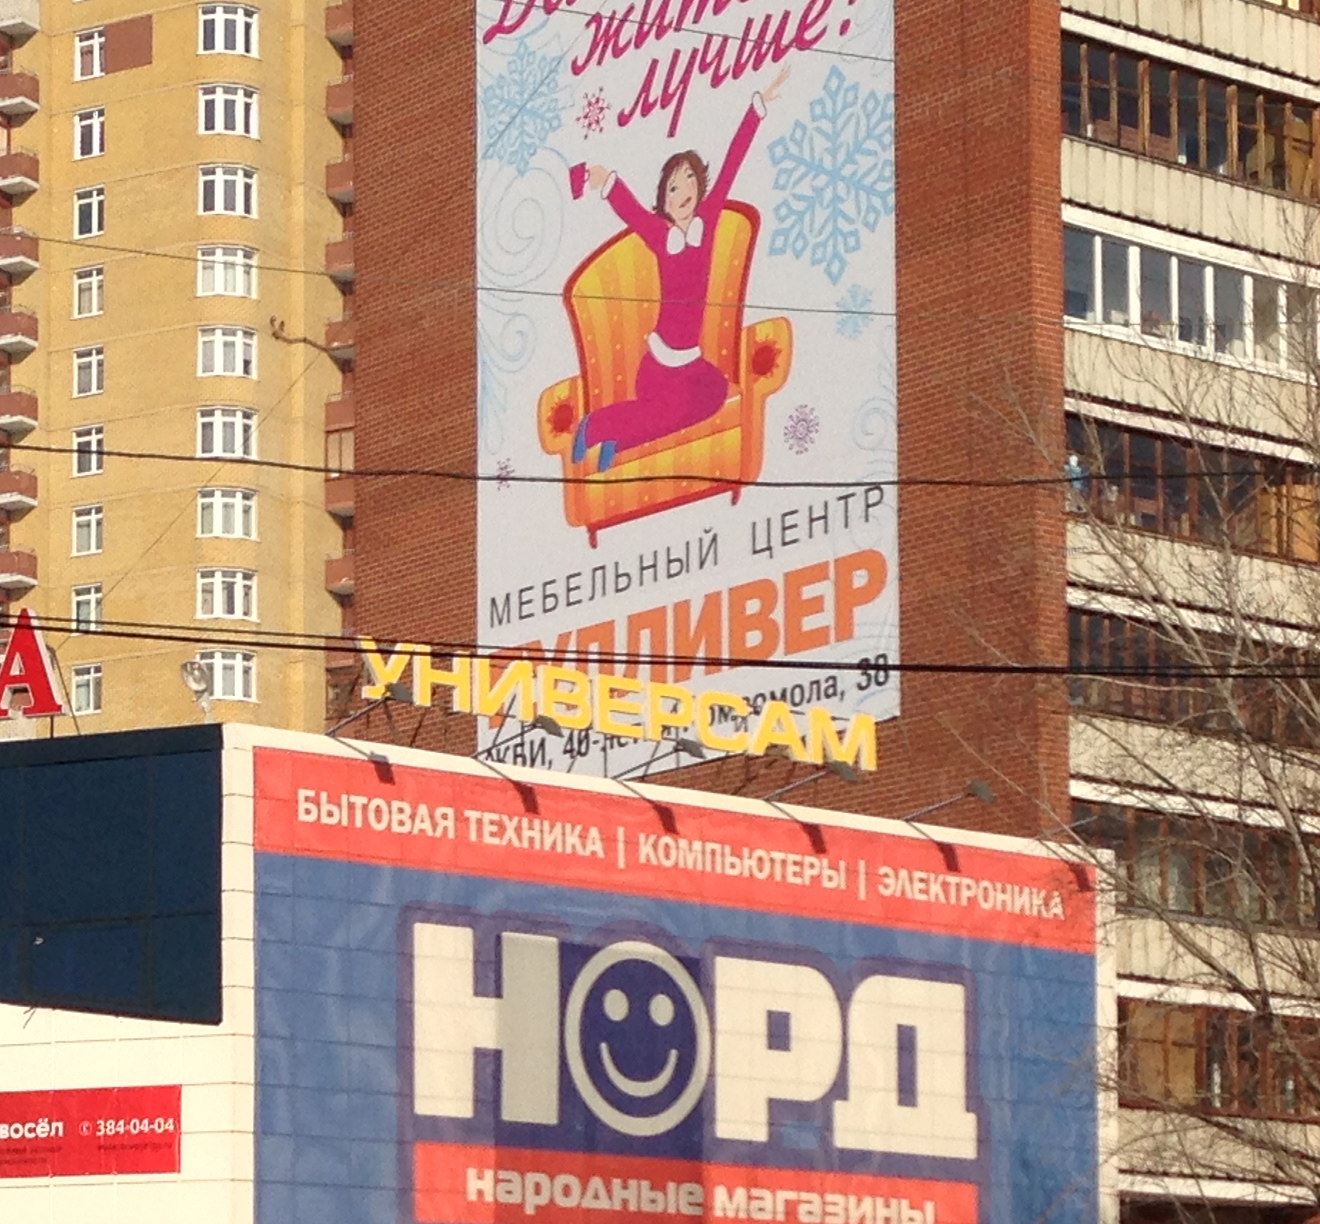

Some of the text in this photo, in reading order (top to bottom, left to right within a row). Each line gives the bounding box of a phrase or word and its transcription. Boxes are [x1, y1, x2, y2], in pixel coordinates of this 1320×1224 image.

[617, 0, 856, 138] лучше
[489, 485, 884, 628] МЕБЕЛЬНЫЙ ЦЕНТР
[356, 635, 878, 771] УНИВЕРСАМ
[296, 788, 1066, 921] БЫТОВАЯ ТЕХНИКА КОМПЬЮТЕРЫ ЭЛЕКТРОНИКА
[412, 922, 978, 1160] НОРД
[96, 1117, 175, 1136] 384-04-04
[465, 1166, 704, 1214] народные
